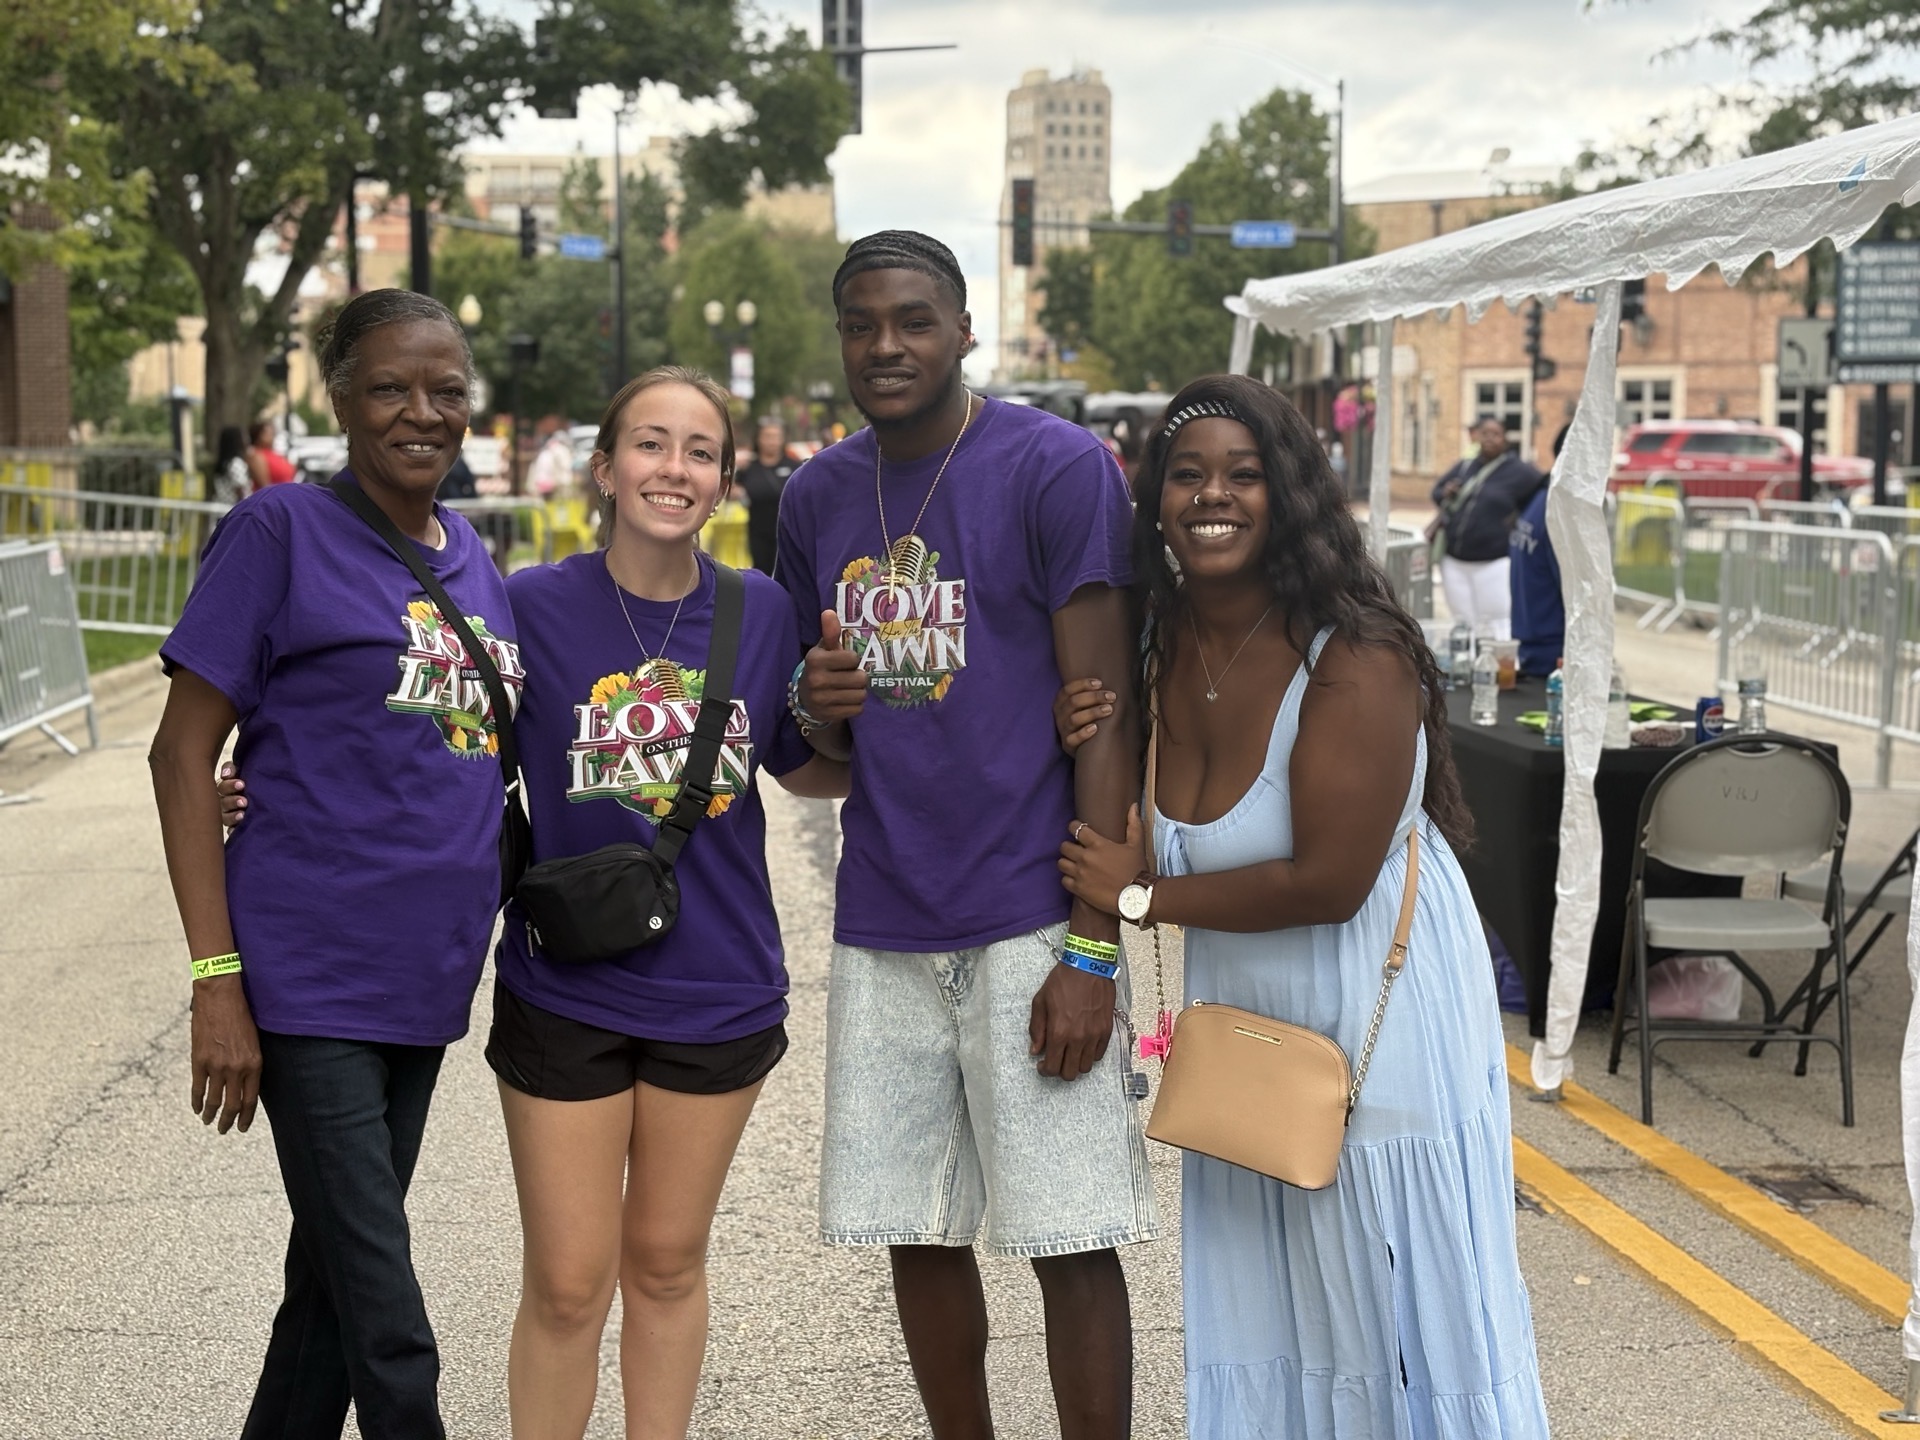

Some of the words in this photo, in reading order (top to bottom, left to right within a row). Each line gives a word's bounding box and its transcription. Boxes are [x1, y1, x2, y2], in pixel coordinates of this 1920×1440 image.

[835, 580, 966, 627] LOVE
[871, 677, 934, 687] FESTIVAL
[646, 742, 665, 754] ON
[666, 736, 692, 748] THE
